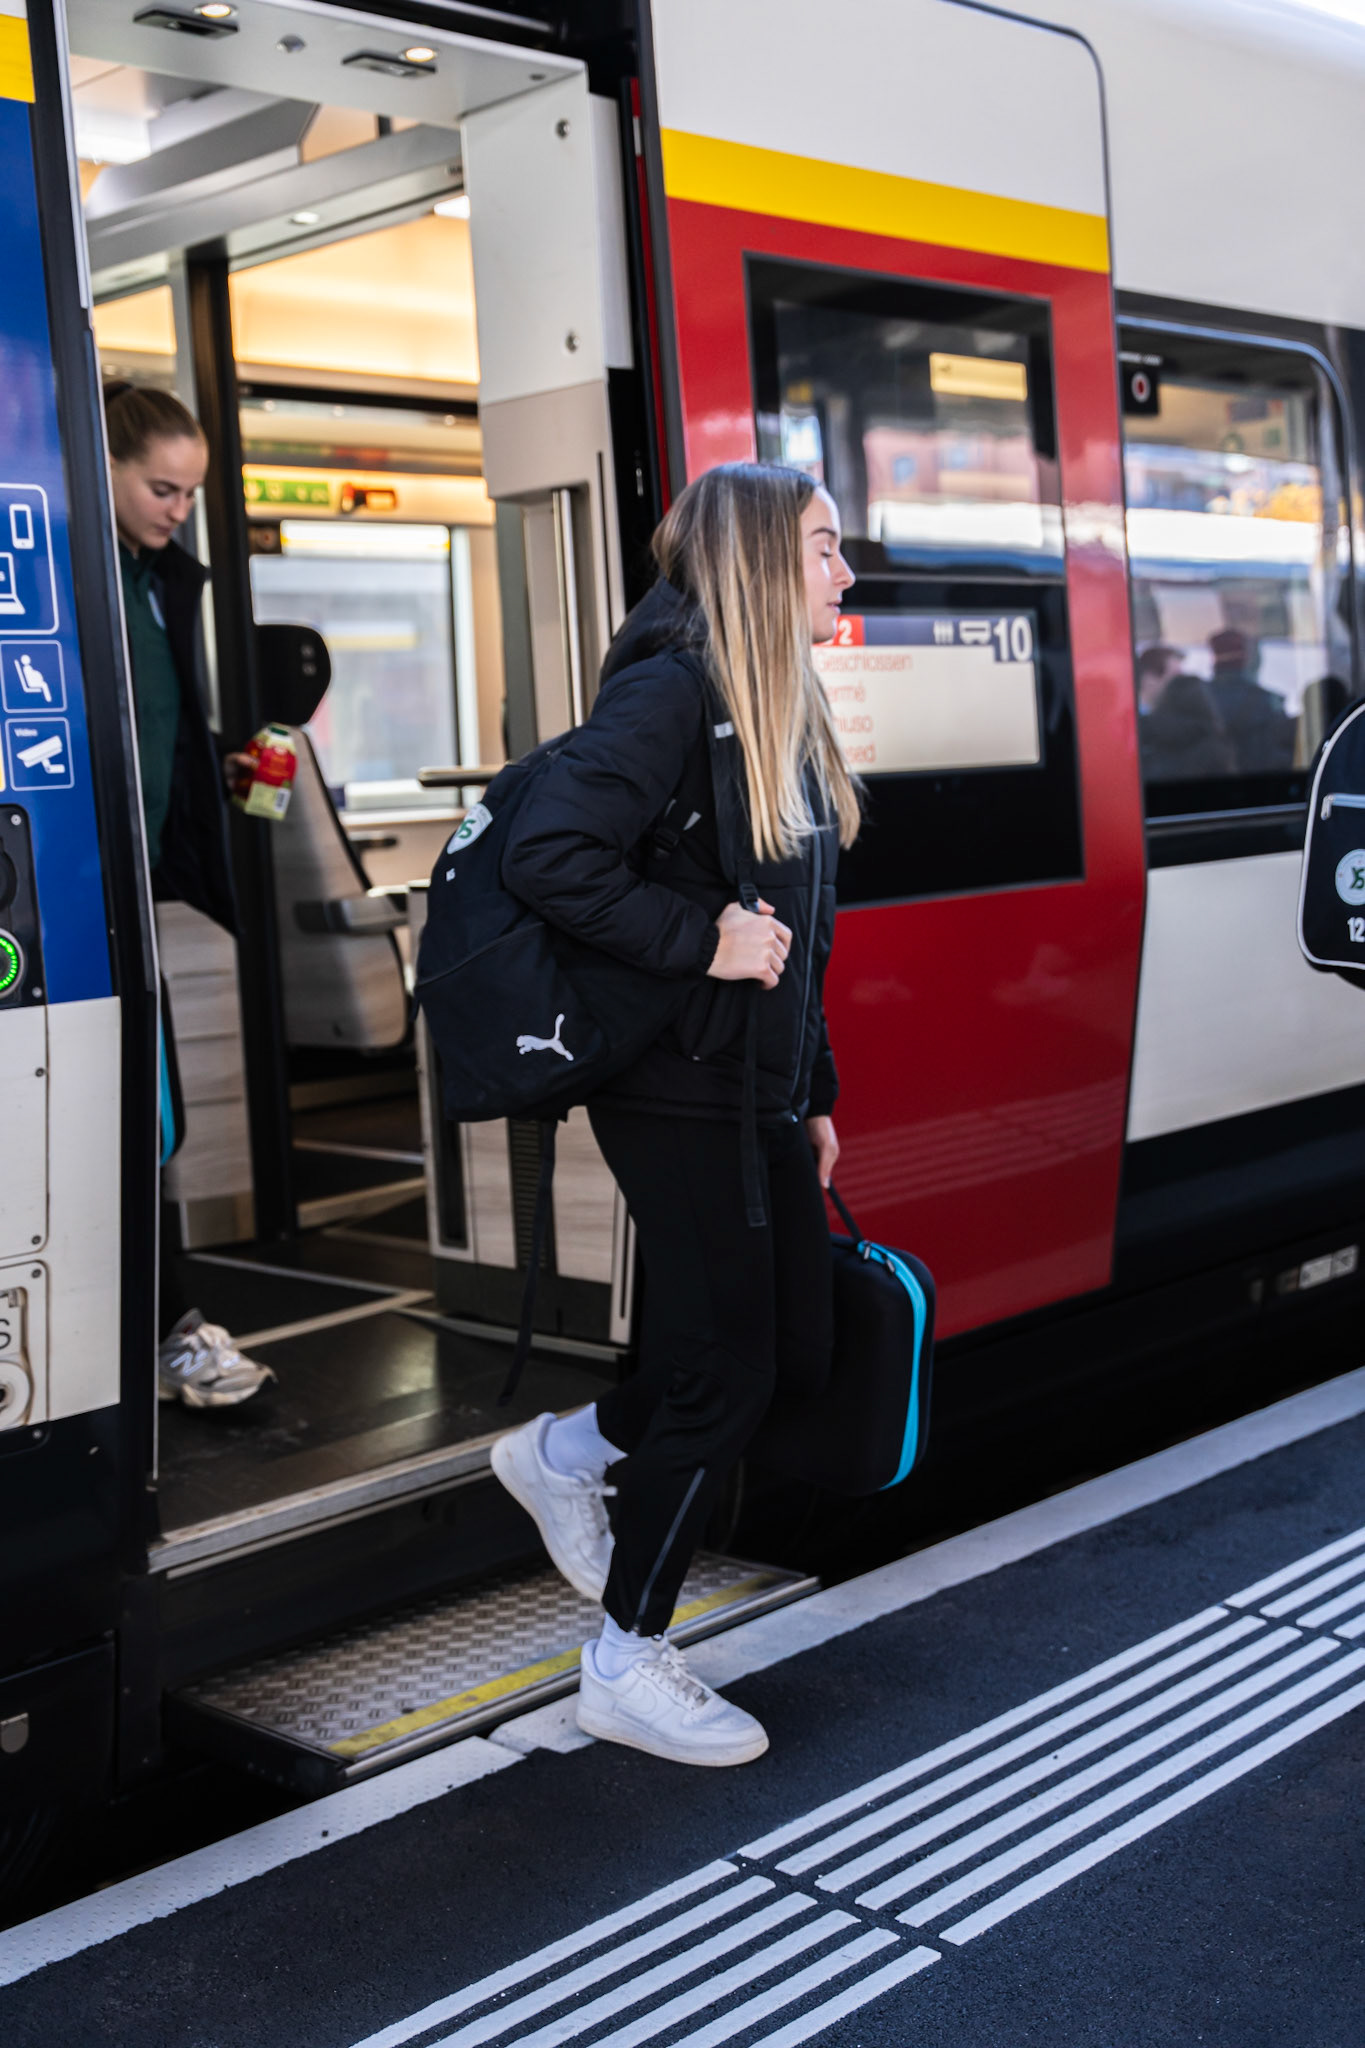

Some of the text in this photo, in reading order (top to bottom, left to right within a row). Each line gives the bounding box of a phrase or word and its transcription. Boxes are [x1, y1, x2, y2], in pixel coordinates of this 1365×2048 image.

[837, 616, 1034, 662] 2 10
[826, 680, 866, 702] ermé
